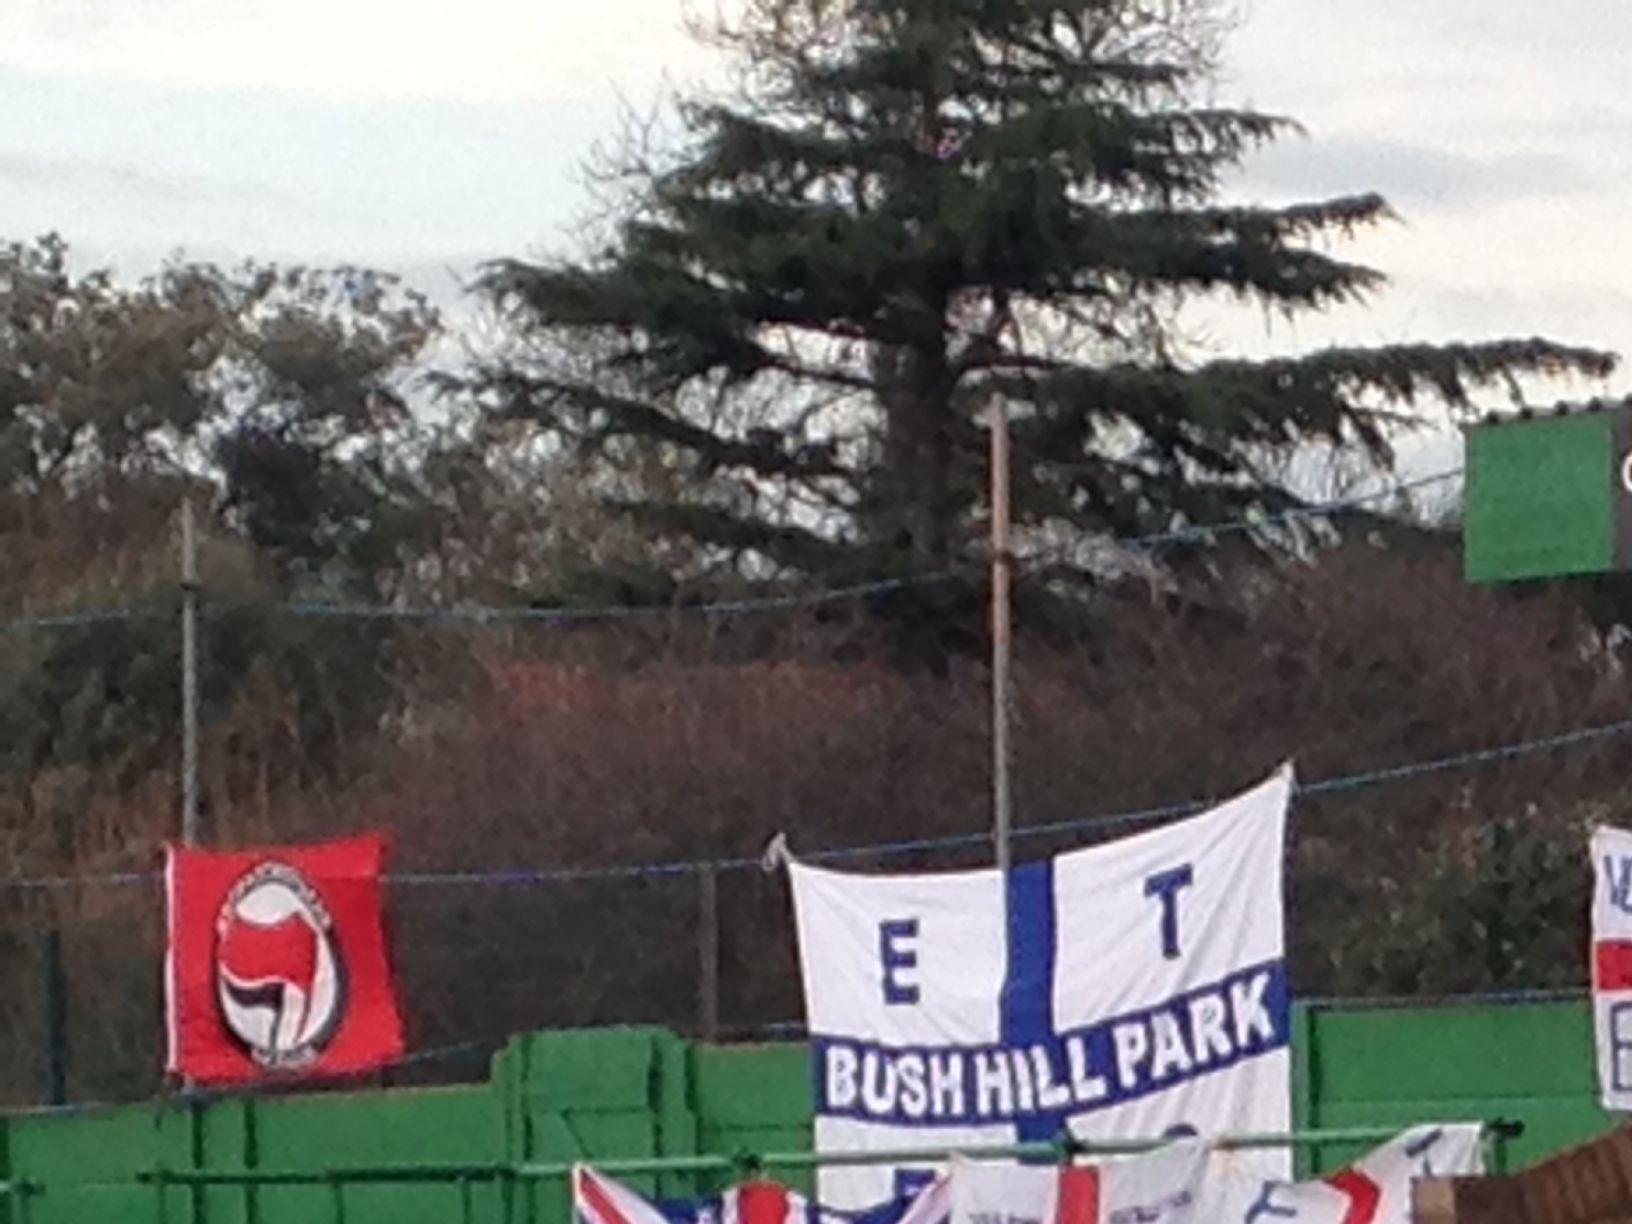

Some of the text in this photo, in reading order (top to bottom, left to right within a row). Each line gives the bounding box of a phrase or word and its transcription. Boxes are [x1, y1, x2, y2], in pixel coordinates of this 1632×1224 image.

[878, 862, 1194, 1006] E T
[825, 970, 1276, 1117] BUSH HILL PARK
